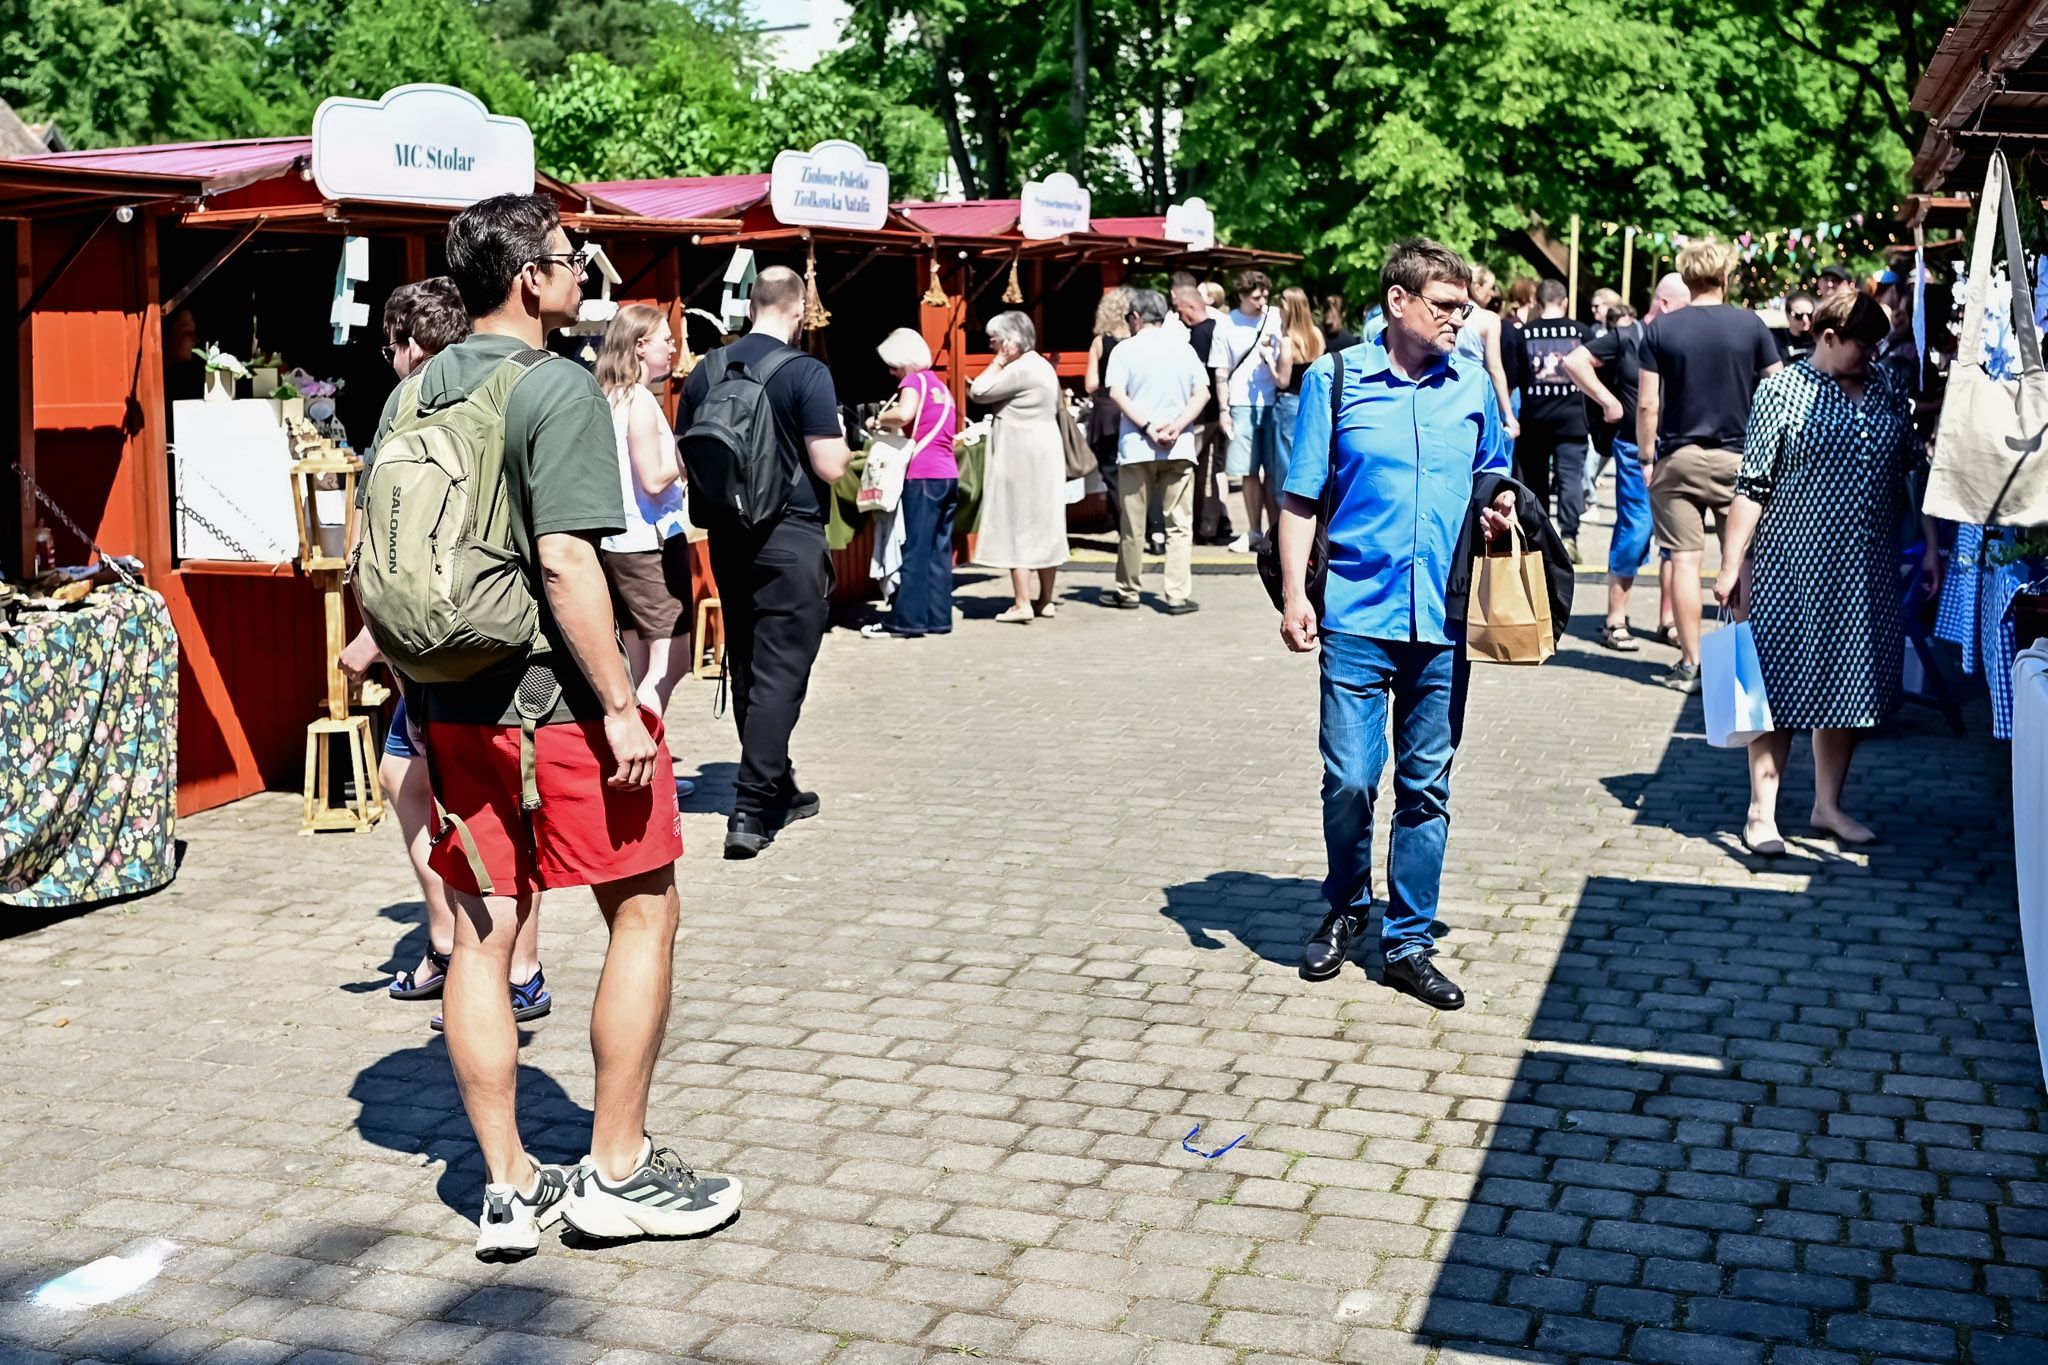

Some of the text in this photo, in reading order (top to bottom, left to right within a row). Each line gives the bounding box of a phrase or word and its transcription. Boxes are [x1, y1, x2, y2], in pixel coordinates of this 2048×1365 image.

[394, 143, 475, 171] MC Stolar
[388, 485, 402, 575] SALOMON
